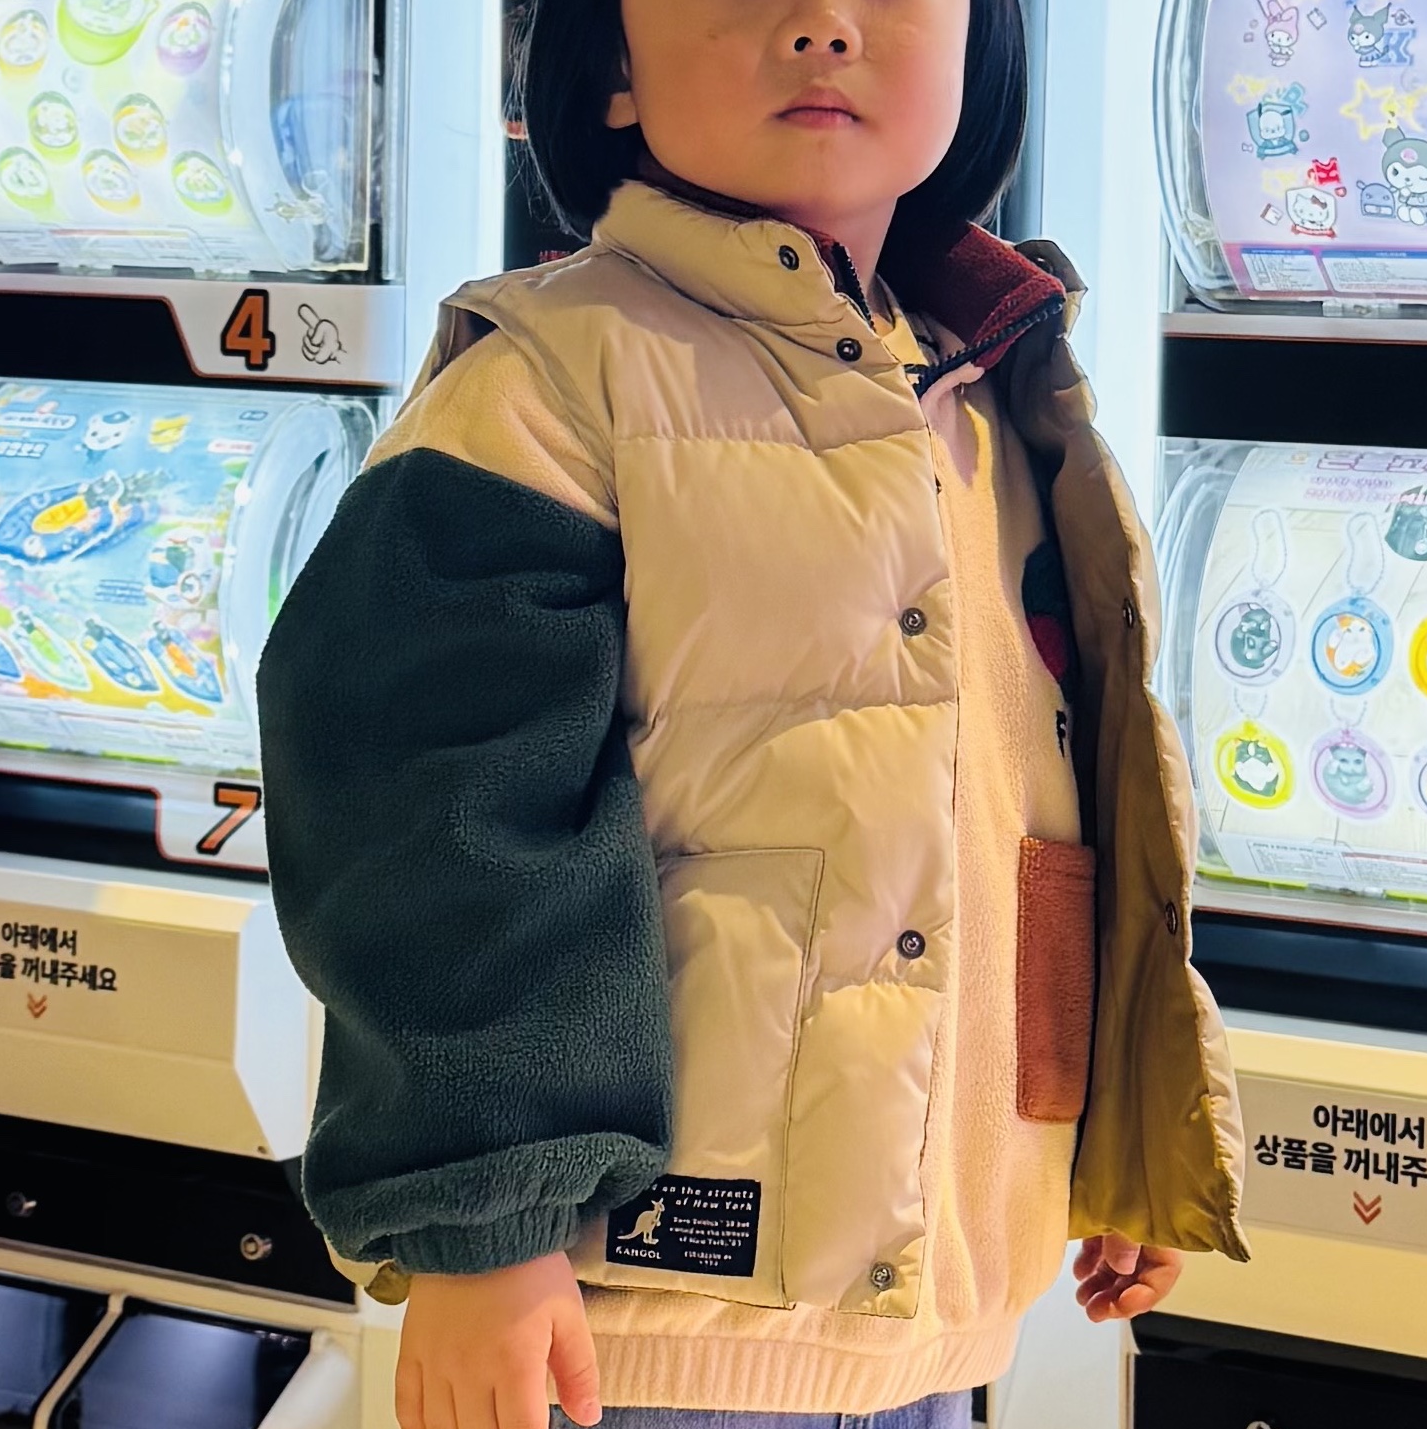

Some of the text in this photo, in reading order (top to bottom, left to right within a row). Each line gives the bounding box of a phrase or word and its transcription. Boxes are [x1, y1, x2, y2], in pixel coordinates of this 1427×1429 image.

[220, 289, 276, 371] 4
[196, 783, 262, 854] 7
[1, 922, 78, 955] 아래에서
[21, 958, 118, 992] 꺼내주세요
[1312, 1104, 1426, 1149] 아래에서
[1254, 1134, 1337, 1175] 상품을
[681, 1186, 701, 1196] the
[693, 1199, 720, 1209] New
